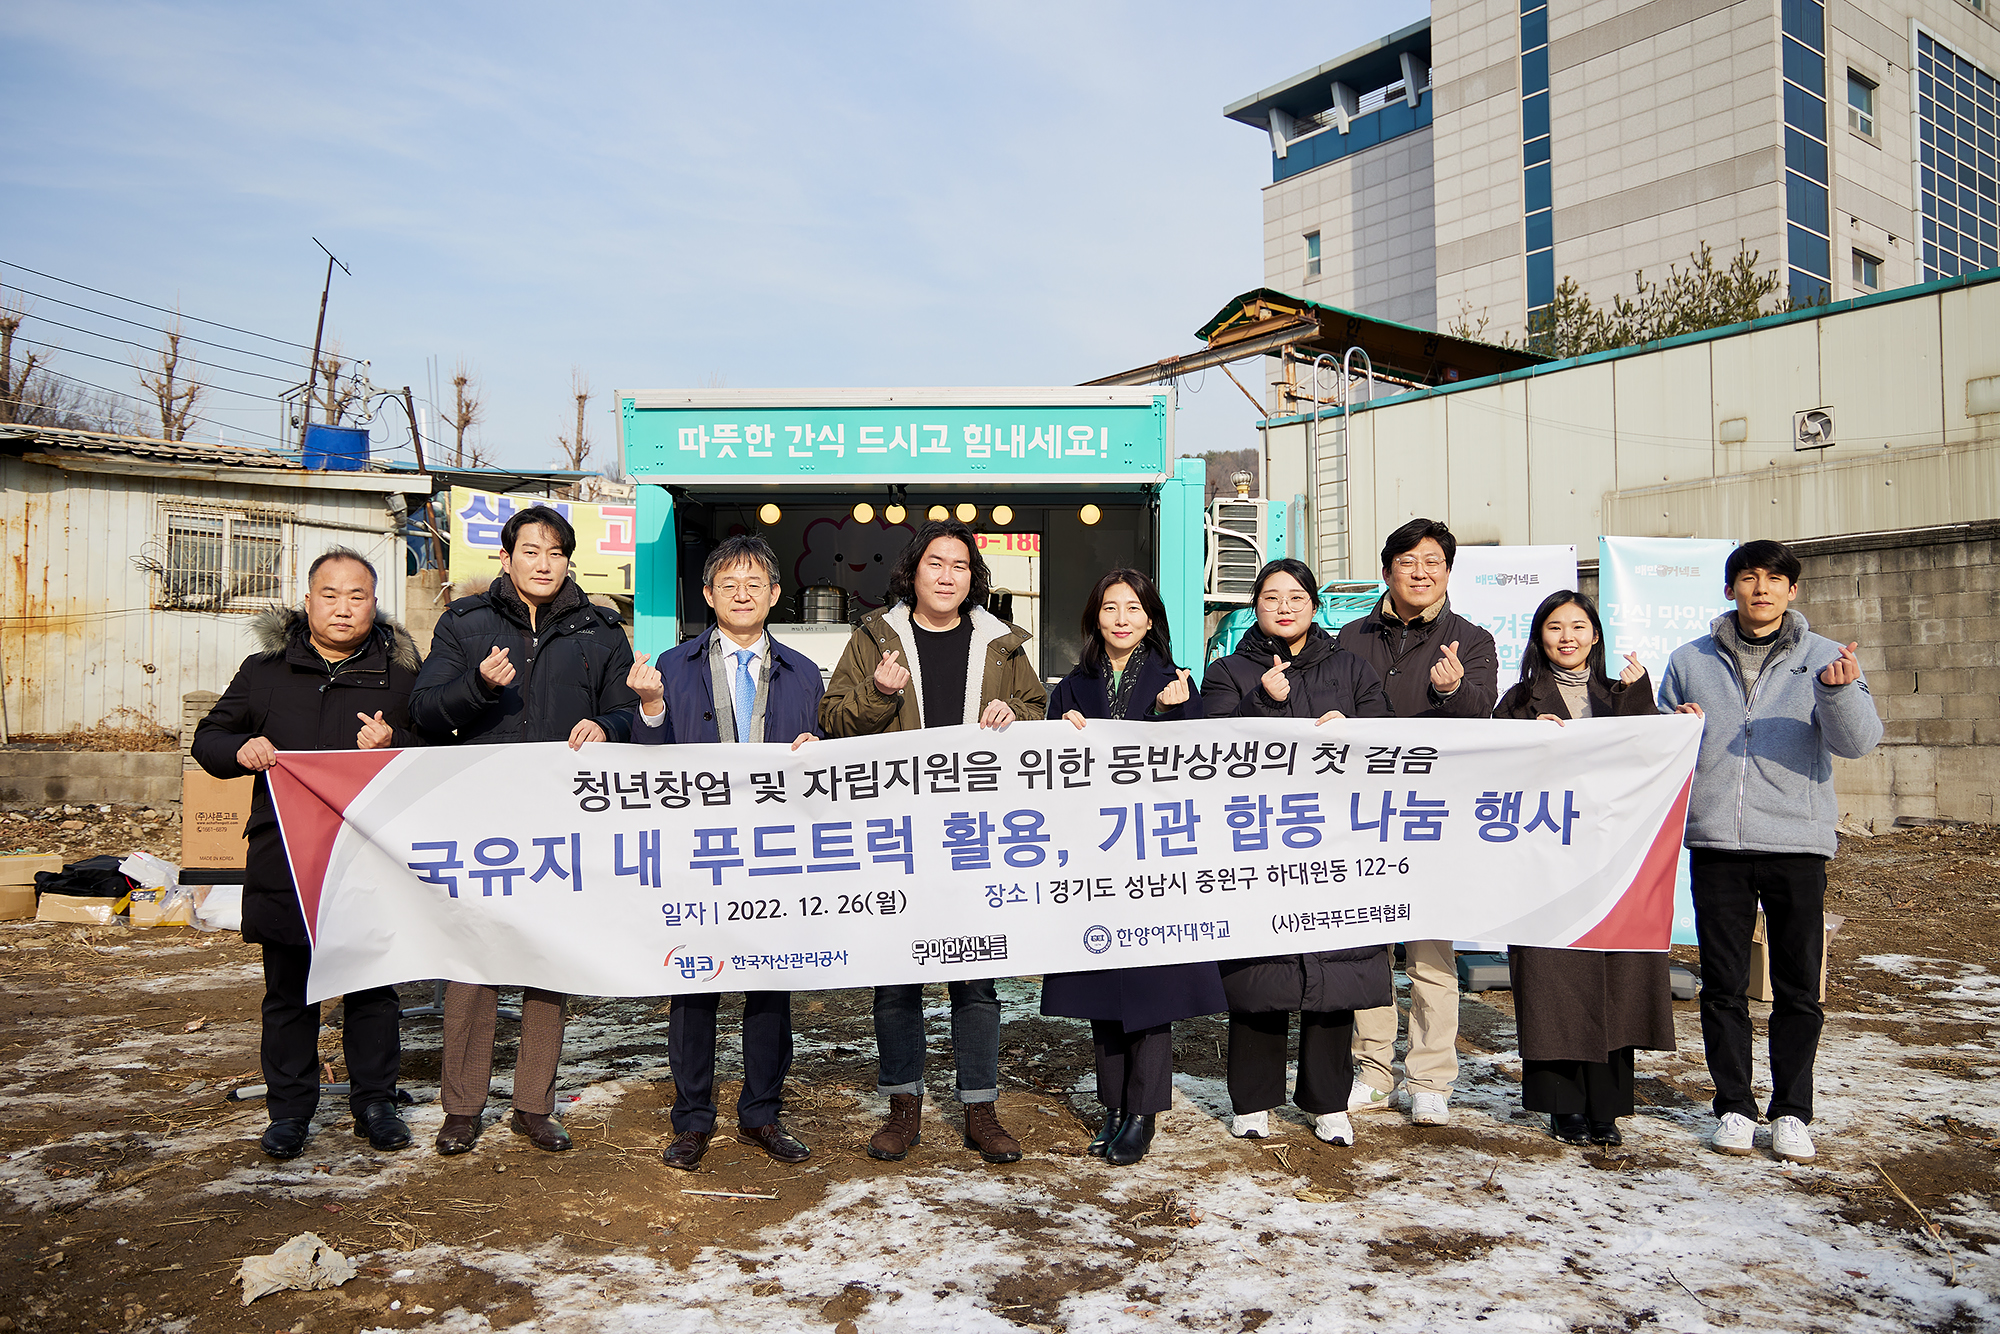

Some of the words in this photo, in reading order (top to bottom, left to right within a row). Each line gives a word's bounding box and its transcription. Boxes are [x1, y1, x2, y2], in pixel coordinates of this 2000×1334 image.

[678, 424, 776, 458] 따뜻한
[785, 424, 844, 458] 간식
[857, 424, 951, 457] 드시고
[963, 424, 1108, 459] 힘내세요!
[1607, 603, 1652, 629] 간식
[572, 769, 732, 812] 청년창업
[749, 770, 787, 804] 및
[802, 750, 1002, 802] 자립지원을
[1017, 747, 1095, 790] 위한
[1107, 741, 1299, 785] 동반상생의
[1311, 742, 1350, 776] 첫
[1364, 745, 1440, 775] 걸음
[407, 832, 583, 899] 국유지
[613, 828, 661, 889] 내
[688, 815, 915, 887] 푸드트럭
[942, 808, 1069, 871] 활용,
[1098, 797, 1202, 862] 기관
[1223, 791, 1327, 852] 합동
[1349, 790, 1450, 843] 나눔
[1474, 789, 1581, 847] 행사
[984, 882, 1028, 908] 장소
[1048, 875, 1116, 904] 경기도
[1124, 870, 1188, 897] 성남시
[1195, 867, 1259, 893] 중원구
[1266, 859, 1349, 887] 하대원동
[1355, 856, 1410, 879] 122-6
[661, 901, 707, 927] 일자
[727, 900, 788, 921] 2022.
[798, 897, 829, 917] 12.
[837, 889, 908, 916] 26(월)
[1271, 902, 1412, 934] (사)한국푸드트럭협회
[911, 934, 1008, 965] 우아한청년들
[1116, 920, 1231, 948] 한양여자대학교
[674, 955, 714, 979] 캠코
[730, 950, 849, 971] 한국자산관리공사
